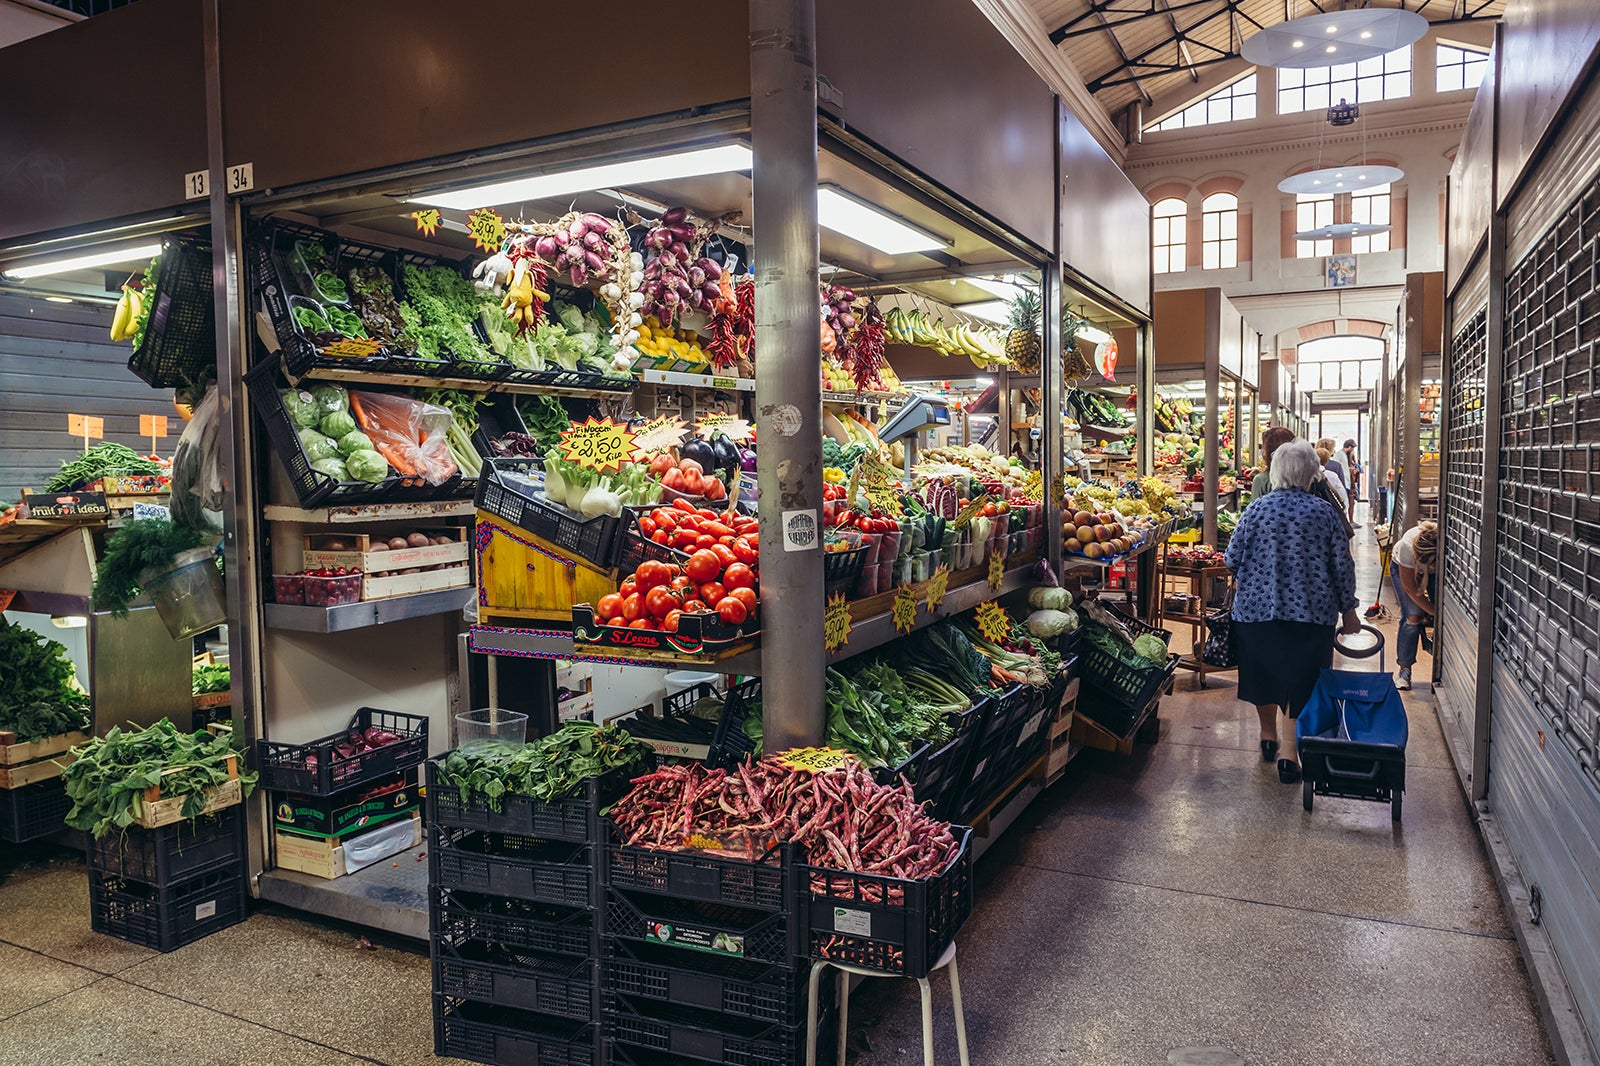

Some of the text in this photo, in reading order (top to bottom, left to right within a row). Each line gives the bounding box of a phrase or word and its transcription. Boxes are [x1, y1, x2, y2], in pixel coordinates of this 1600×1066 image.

[191, 174, 204, 195] 13
[233, 167, 247, 190] 34
[570, 436, 621, 457] € 2,50
[31, 506, 55, 518] fruit
[77, 503, 106, 514] ideas
